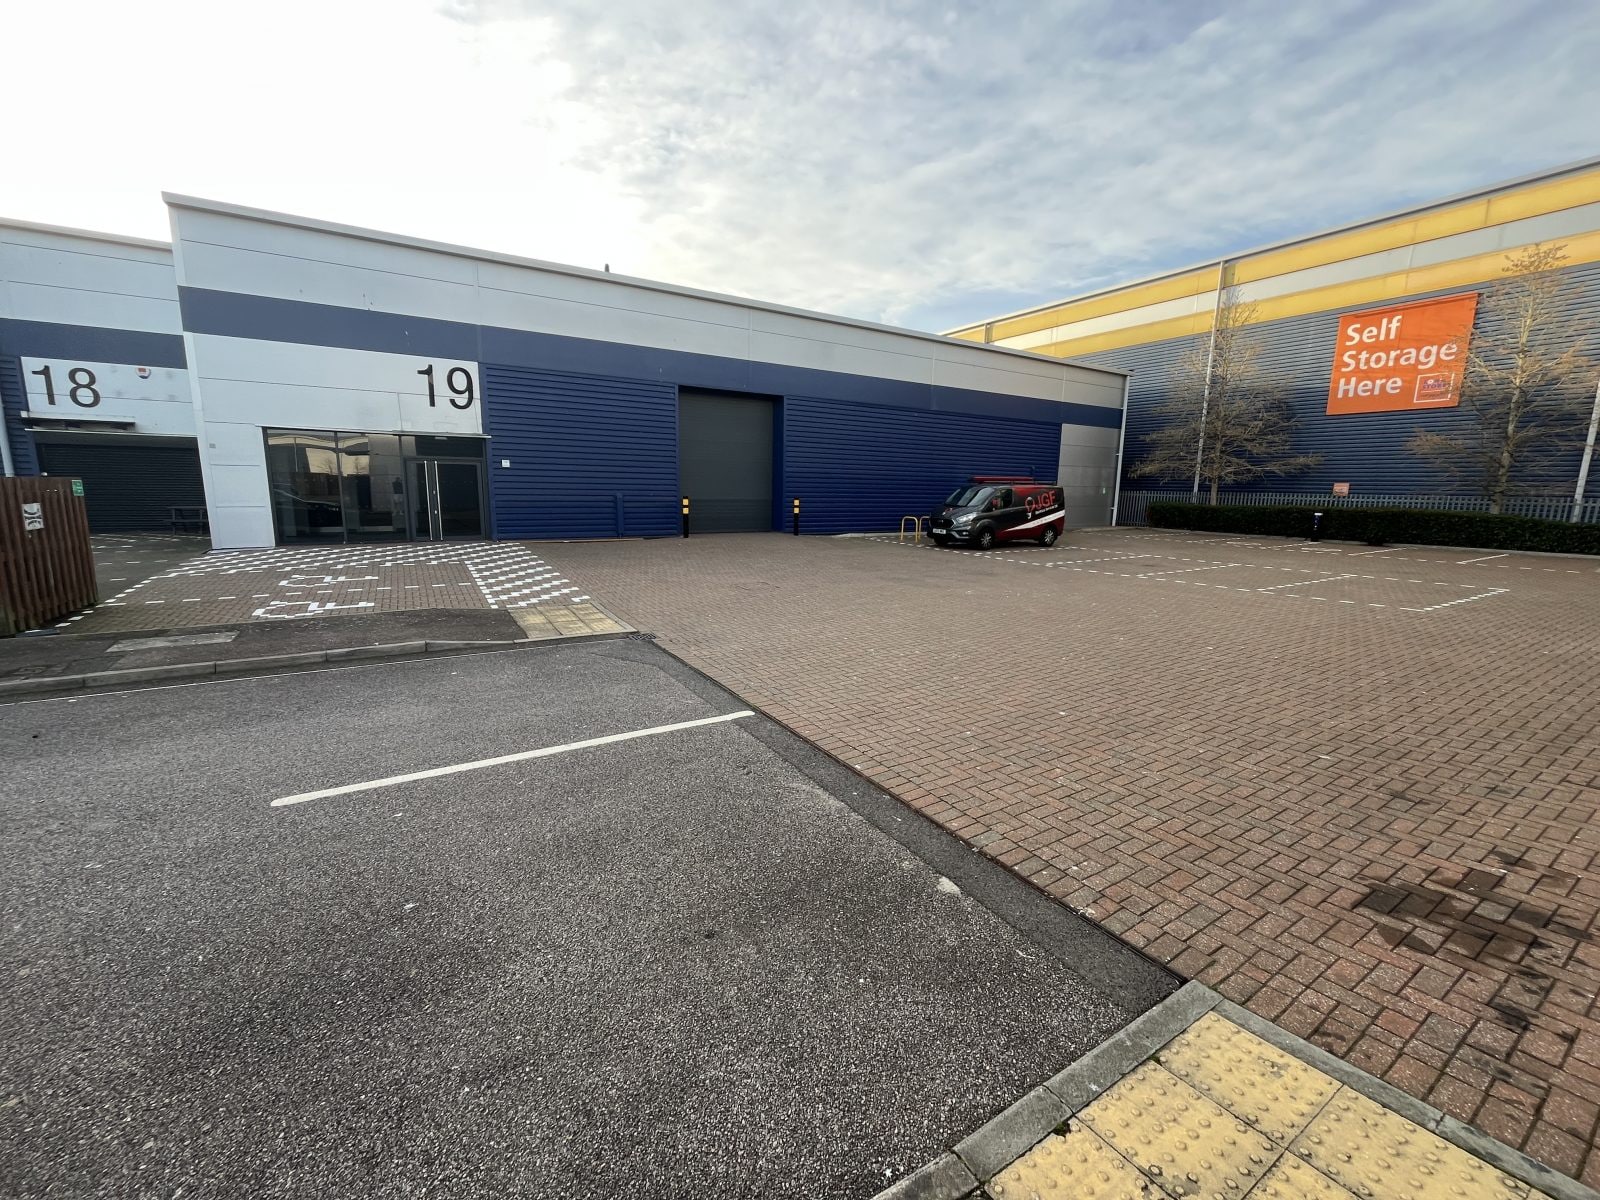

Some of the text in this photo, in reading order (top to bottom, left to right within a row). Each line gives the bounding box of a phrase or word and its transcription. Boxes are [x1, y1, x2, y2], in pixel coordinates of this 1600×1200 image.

[1345, 315, 1402, 346] Self
[1341, 343, 1457, 373] Storage
[31, 365, 101, 409] 18
[417, 364, 474, 410] 19
[1337, 377, 1403, 399] Here
